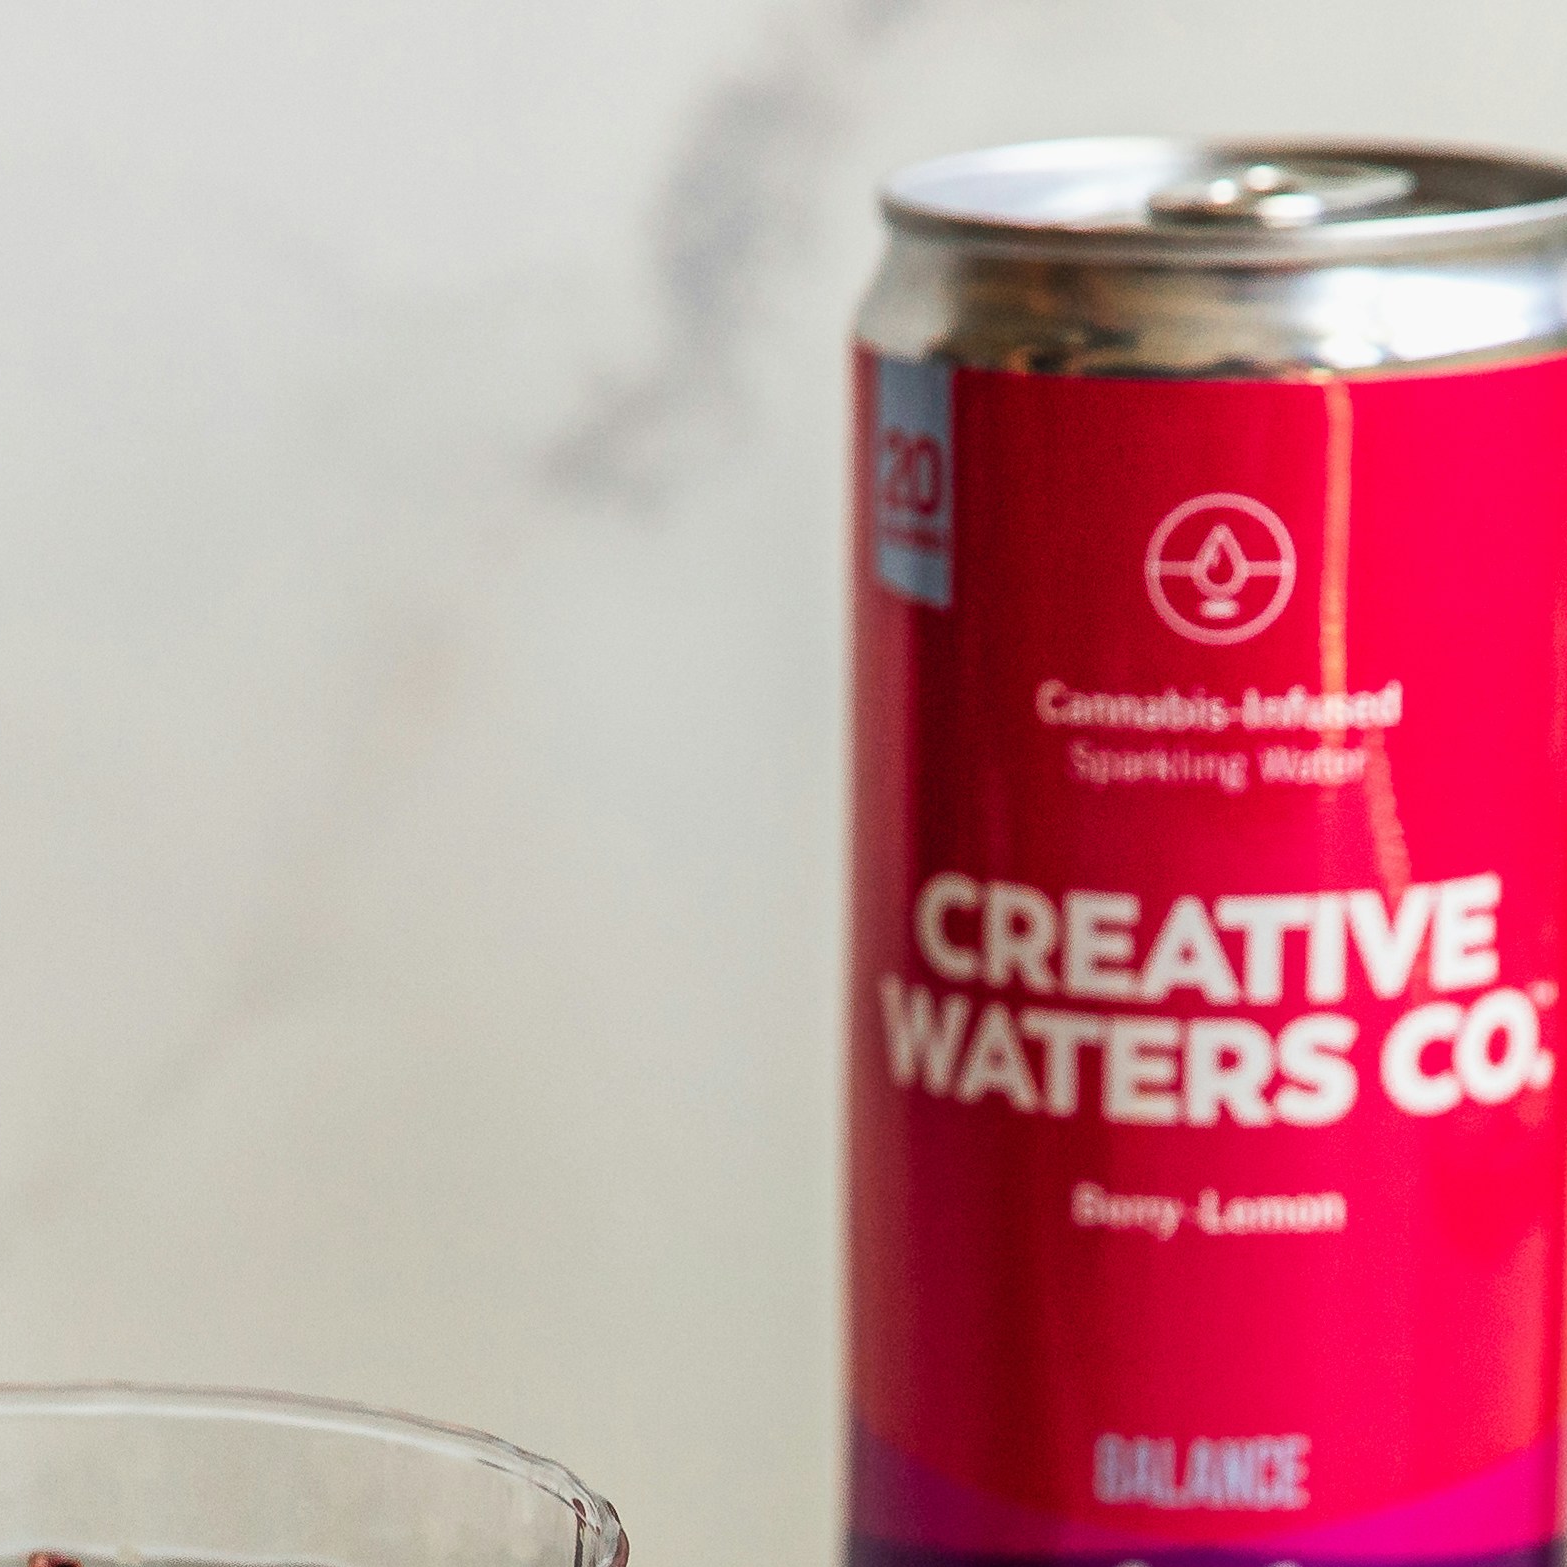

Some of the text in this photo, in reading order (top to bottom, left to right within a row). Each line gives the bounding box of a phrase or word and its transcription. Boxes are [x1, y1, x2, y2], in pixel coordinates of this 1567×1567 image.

[1070, 741, 1370, 790] Sparkling Water
[915, 872, 1501, 1004] CREATIVE
[882, 974, 1359, 1125] WATERS
[1094, 1434, 1309, 1510] BALANCE
